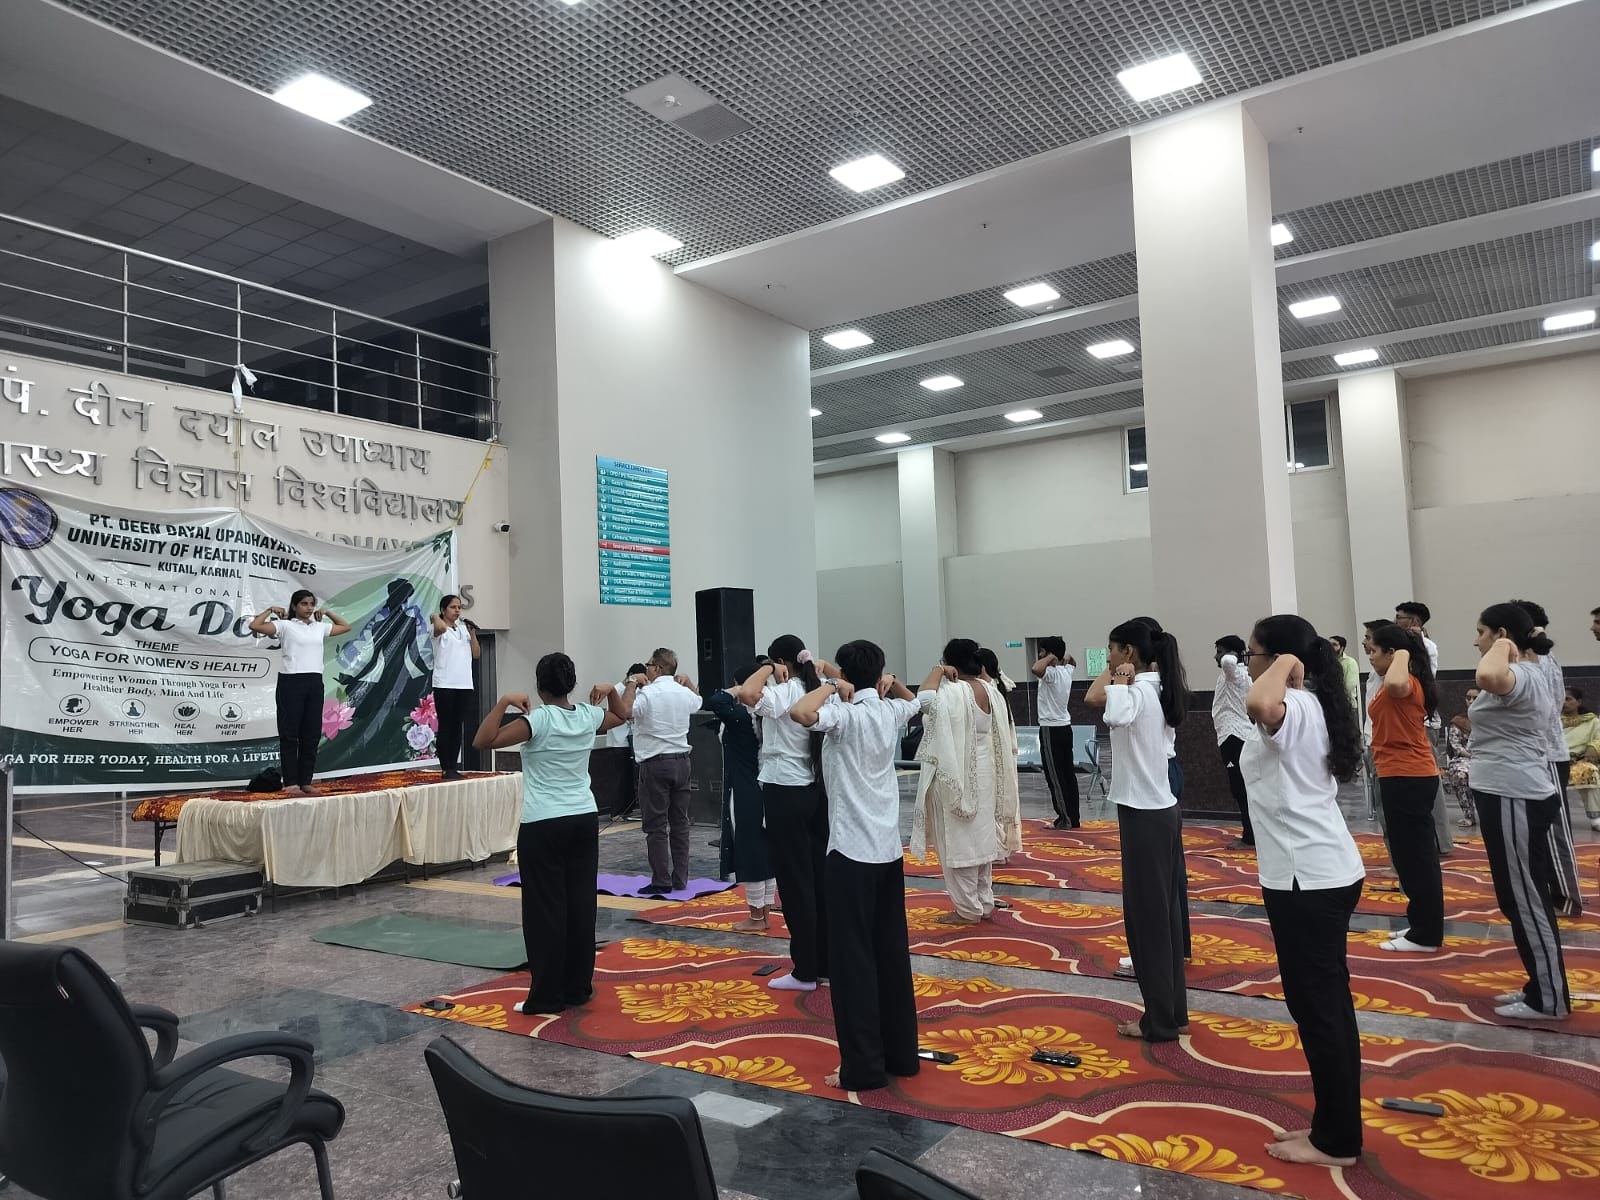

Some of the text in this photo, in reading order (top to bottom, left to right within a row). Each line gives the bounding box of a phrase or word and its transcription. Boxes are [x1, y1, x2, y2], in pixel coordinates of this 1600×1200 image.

[67, 380, 155, 432] दीन
[173, 405, 282, 452] दयाल
[300, 428, 431, 475] उपाध्याय
[0, 441, 466, 526] ास्थ्य विज्ञान विश्वविद्यालय
[89, 513, 113, 529] PT.
[119, 518, 160, 535] DEEN
[166, 524, 211, 541] DAYAL
[67, 527, 317, 576] UNIVERSITY OF HEALTH SCIENCES
[157, 561, 242, 579] KUTAIL, KARNAL
[75, 571, 242, 599] INTERNATIONAL
[11, 575, 281, 650] Yoga Da
[135, 639, 179, 651] THEME
[49, 645, 257, 673] YOGA FOR WOMEN'S HEALTH
[52, 668, 115, 684] Empowering
[118, 675, 158, 686] Women
[160, 677, 197, 689] Through
[199, 680, 220, 690] Yoga
[222, 681, 238, 689] For
[83, 682, 125, 694] Healthier
[160, 688, 185, 698] Mind
[187, 690, 205, 698] And
[207, 690, 225, 699] Life
[49, 717, 99, 726] EMPOWER
[174, 722, 197, 730] HEAL
[0, 751, 281, 766] GA FOR HER TODAY, HEALTH FOR A LIFETI
